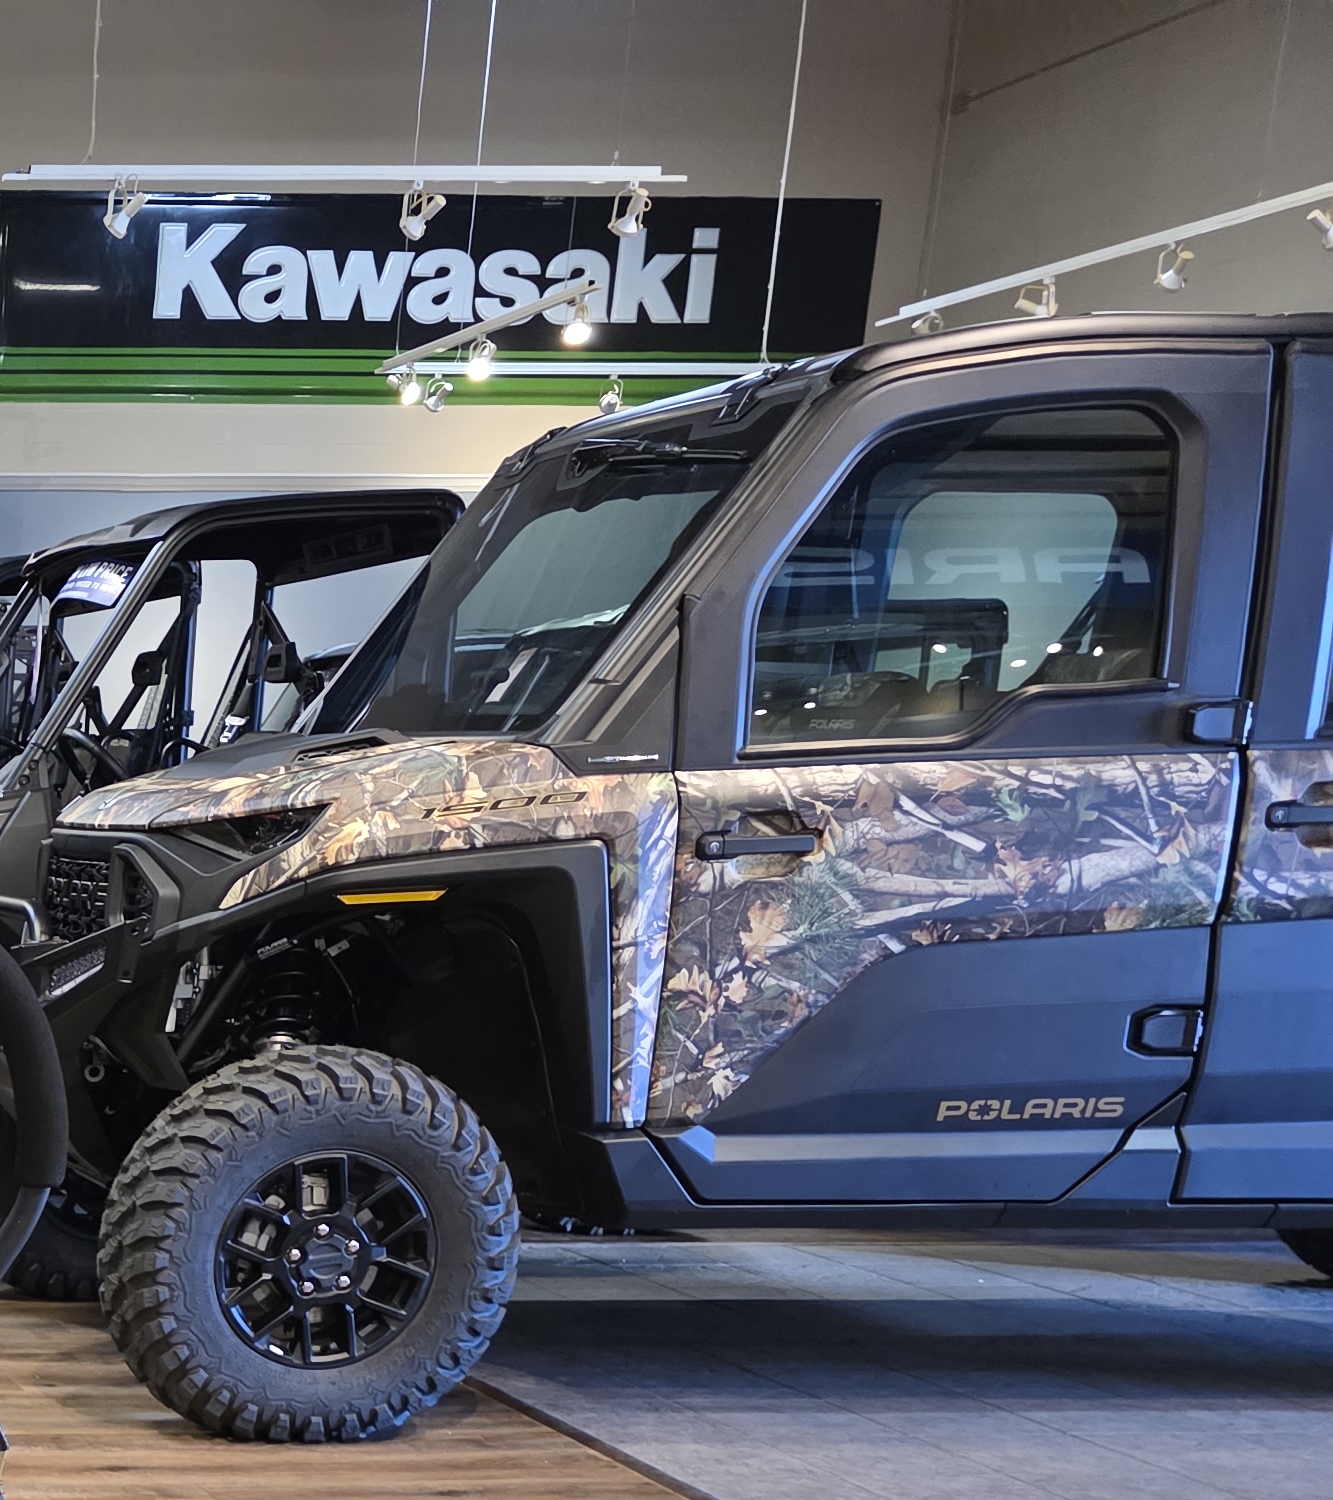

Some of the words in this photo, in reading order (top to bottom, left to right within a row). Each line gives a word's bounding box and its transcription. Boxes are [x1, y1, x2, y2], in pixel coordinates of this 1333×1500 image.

[153, 222, 720, 325] Kawasaki
[421, 790, 588, 820] 1500
[936, 1096, 1126, 1122] POLARIS
